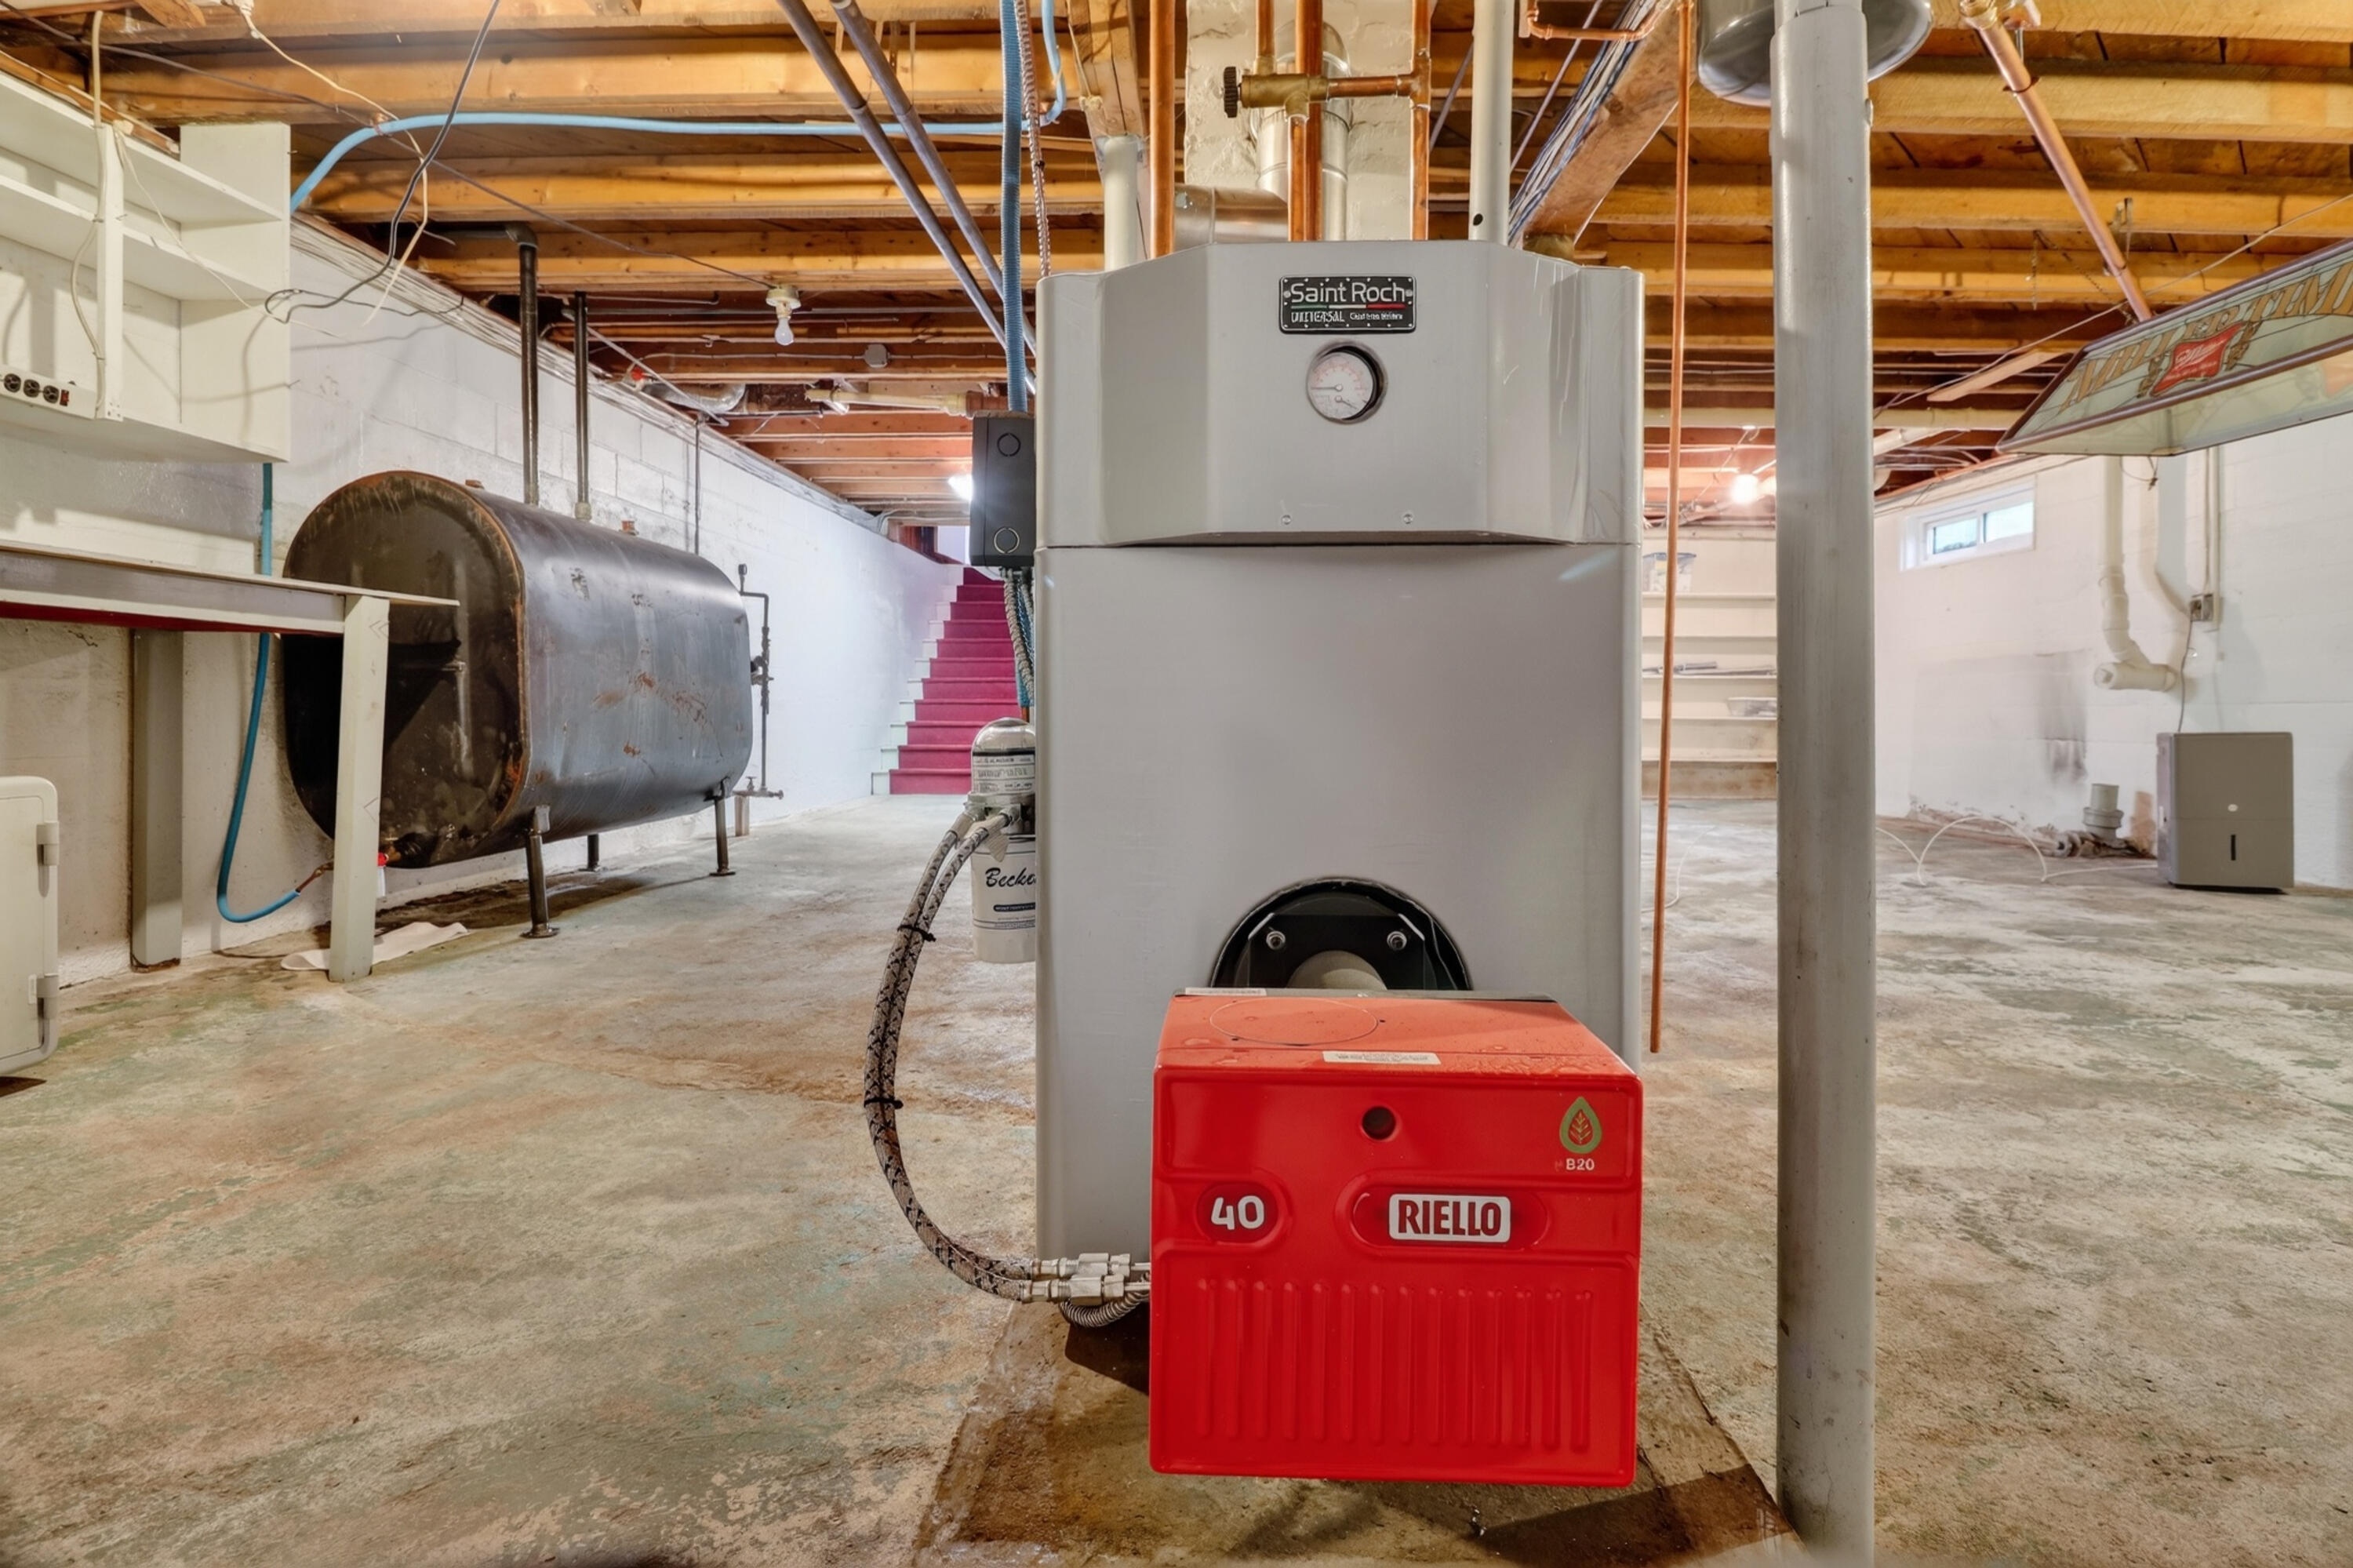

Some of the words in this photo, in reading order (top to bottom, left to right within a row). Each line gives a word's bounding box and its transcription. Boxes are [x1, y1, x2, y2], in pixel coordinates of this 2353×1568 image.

[1290, 282, 1347, 303] Saint
[1351, 282, 1406, 303] Roch
[2244, 260, 2353, 322] TIM
[1566, 1158, 1595, 1171] B20
[1210, 1195, 1265, 1229] 40
[1398, 1200, 1501, 1236] RIELLO
